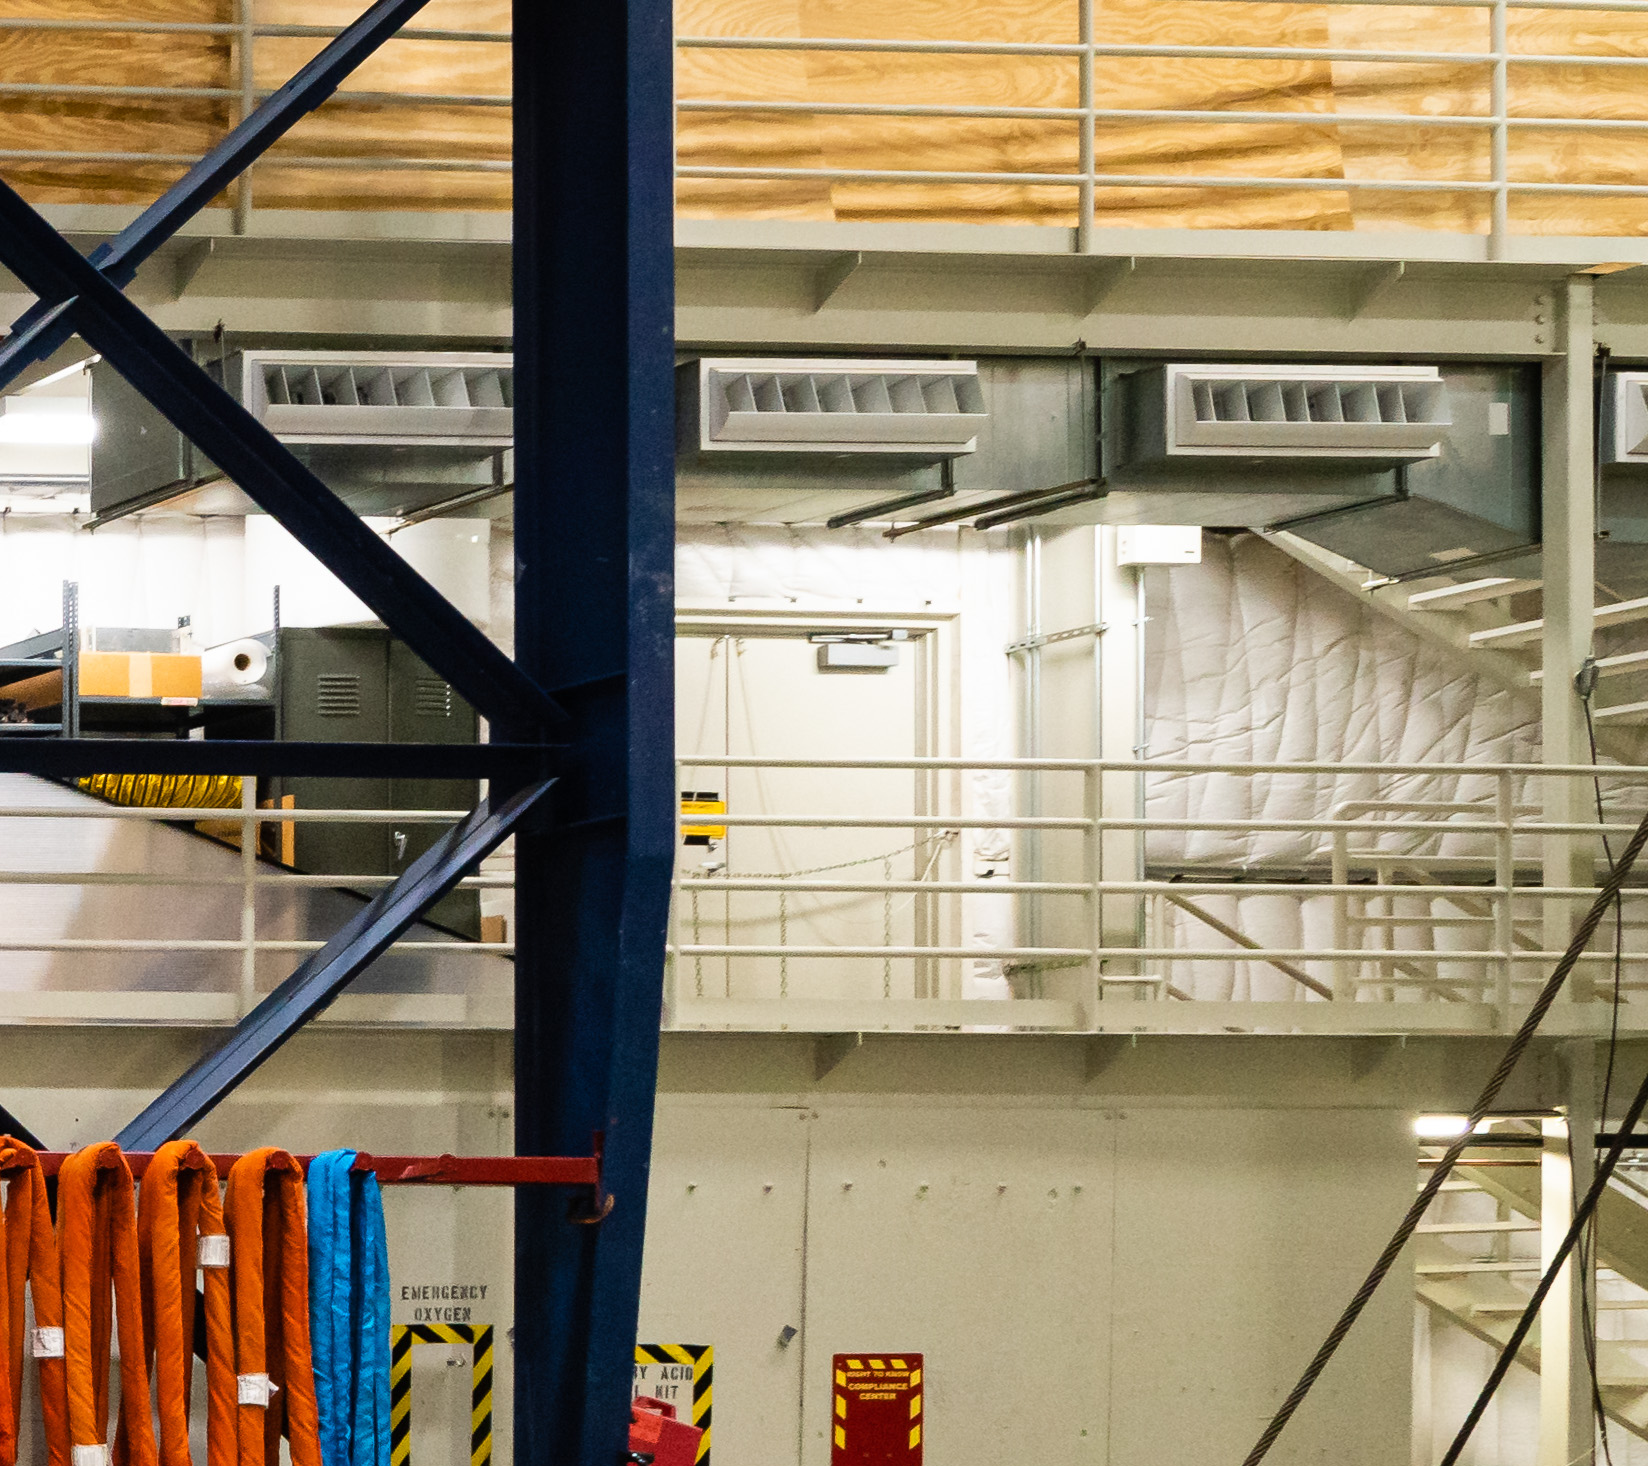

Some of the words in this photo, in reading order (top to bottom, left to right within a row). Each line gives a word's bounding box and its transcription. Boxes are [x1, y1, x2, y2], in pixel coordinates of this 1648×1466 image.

[401, 1285, 487, 1300] EMERGENCY
[414, 1307, 472, 1321] OXYGEN
[660, 1366, 693, 1380] ACID
